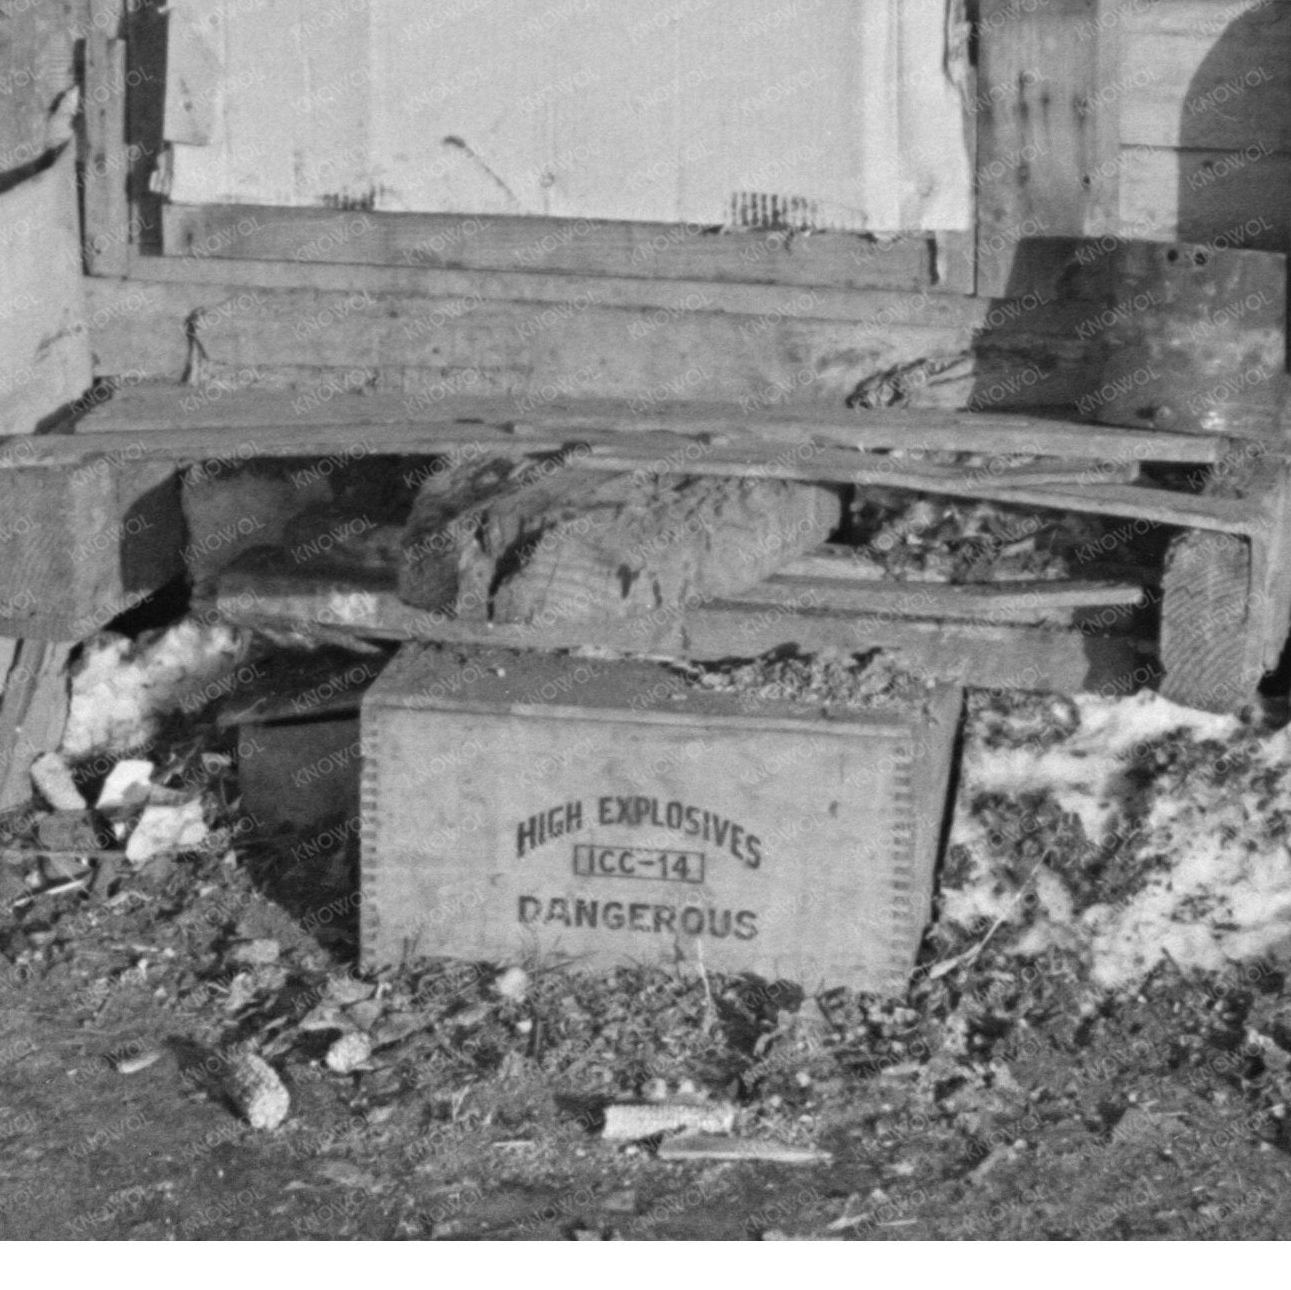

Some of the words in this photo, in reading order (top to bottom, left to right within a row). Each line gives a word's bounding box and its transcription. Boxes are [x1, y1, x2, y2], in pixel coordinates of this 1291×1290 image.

[516, 800, 583, 858] HIGH
[598, 796, 763, 870] EXPLOSIVES
[587, 846, 690, 879] ICC-14
[516, 895, 759, 942] DANGEROUS
